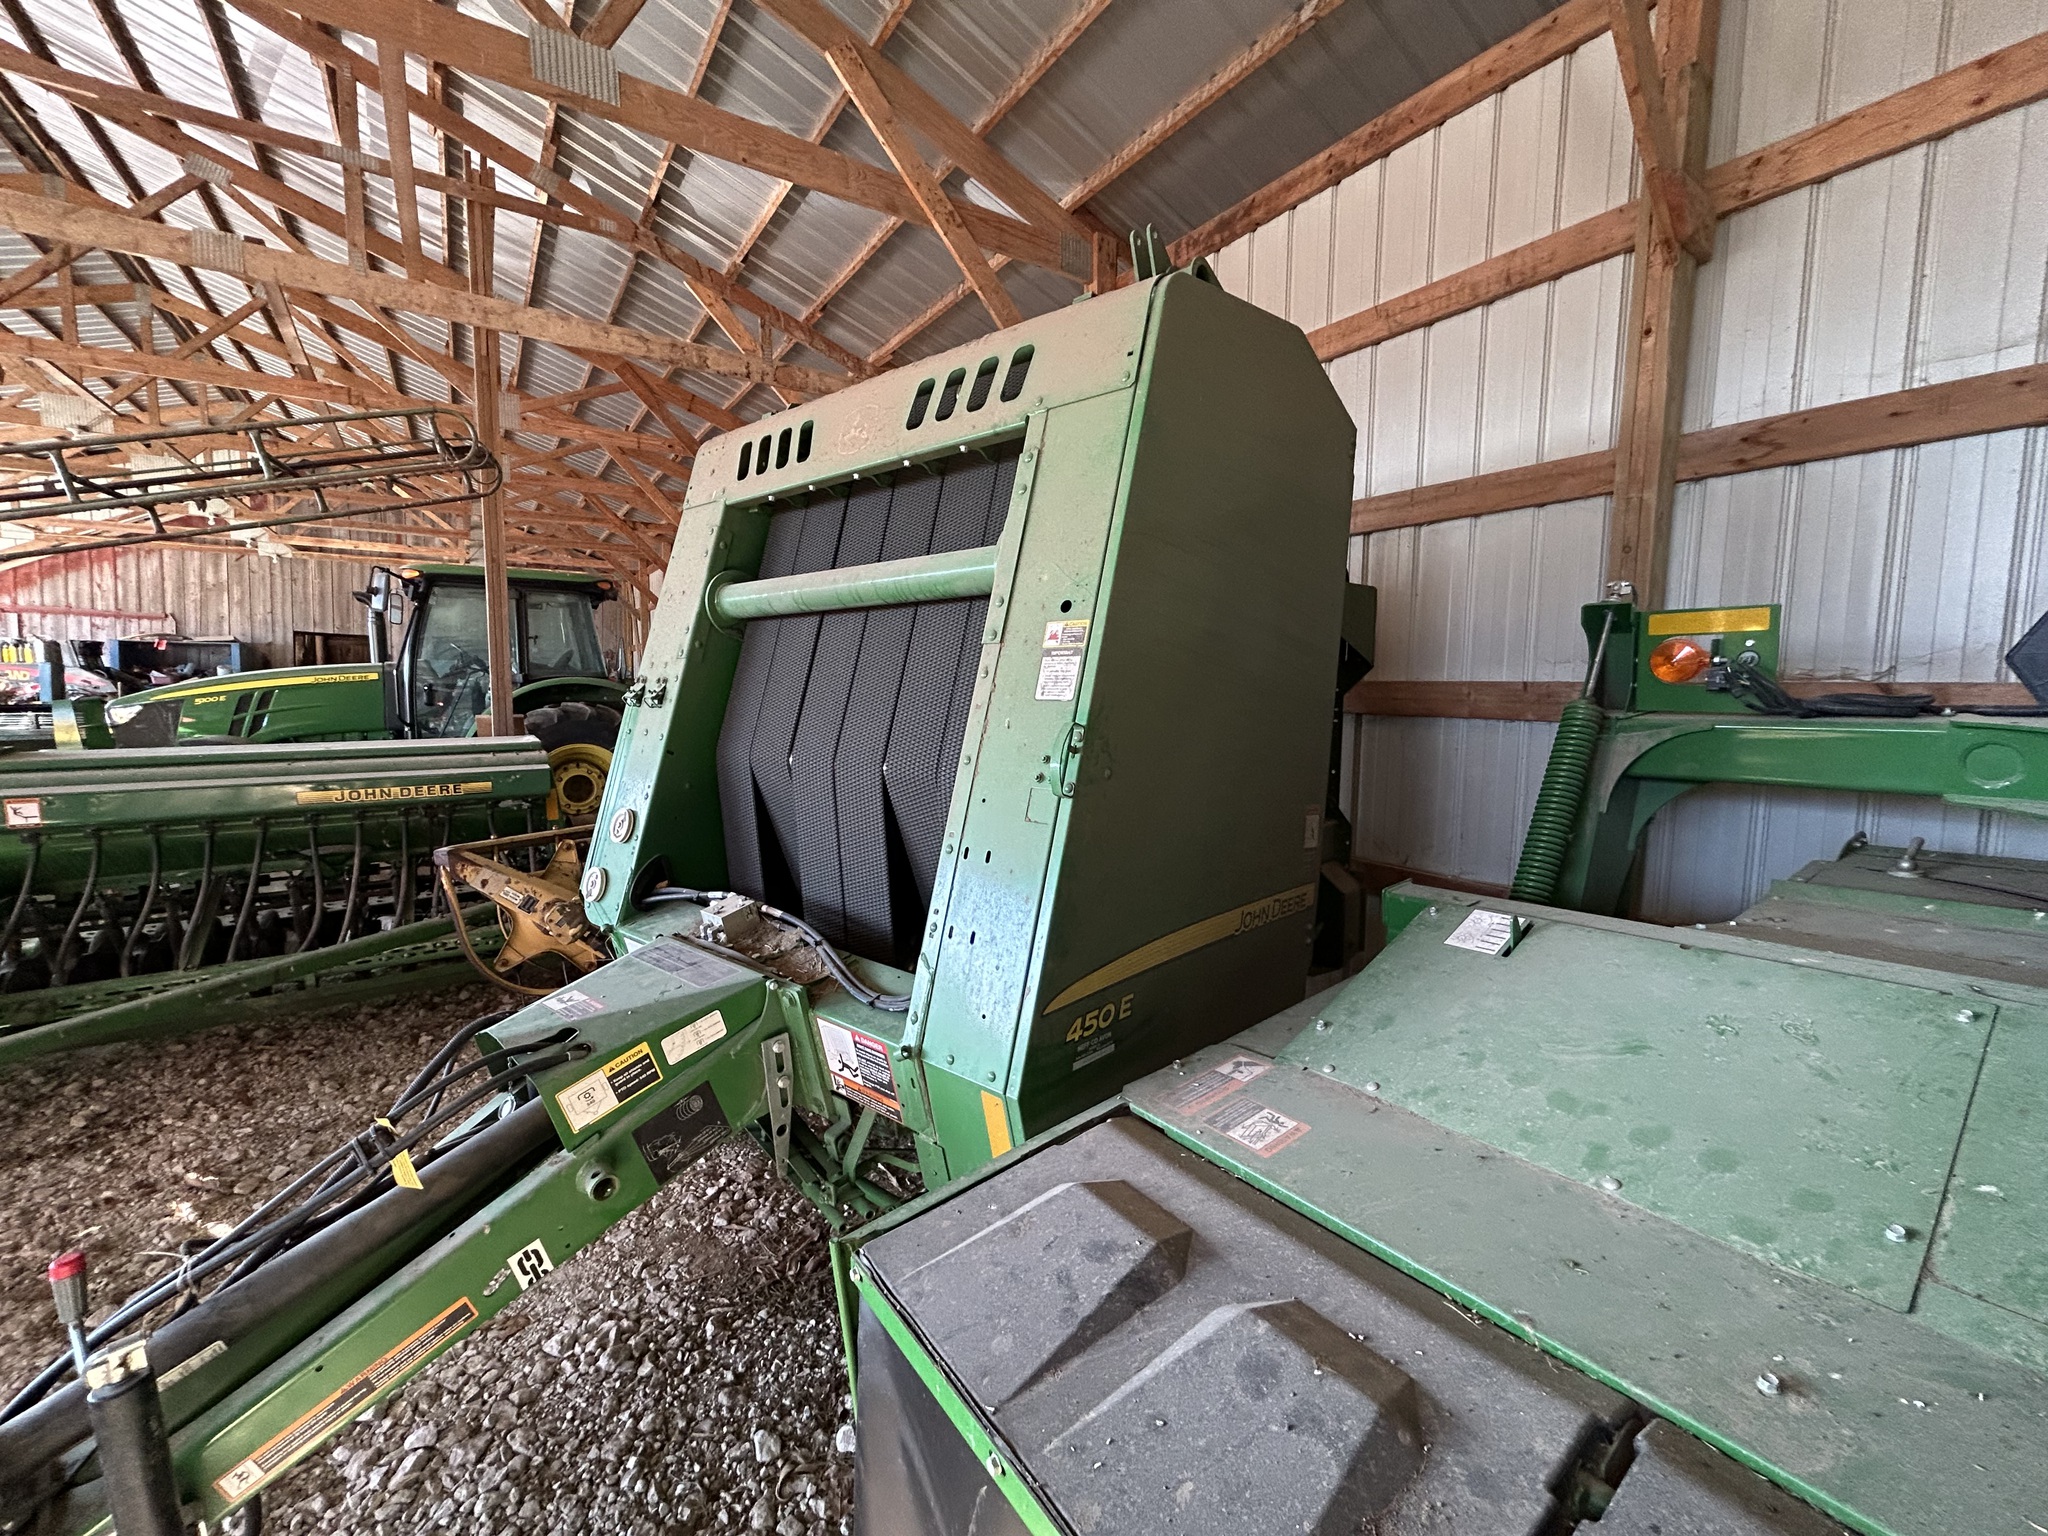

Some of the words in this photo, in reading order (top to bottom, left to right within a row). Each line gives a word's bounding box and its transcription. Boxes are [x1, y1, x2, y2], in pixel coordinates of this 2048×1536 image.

[311, 676, 338, 684] JOHN
[338, 674, 370, 682] DEERE
[334, 788, 393, 803] JOHN
[400, 783, 463, 799] DEERE
[1234, 904, 1270, 934] JOHN
[1271, 892, 1308, 918] DEERE
[1065, 1002, 1116, 1043] 450
[1119, 993, 1134, 1021] E
[614, 1048, 643, 1068] CAUTION
